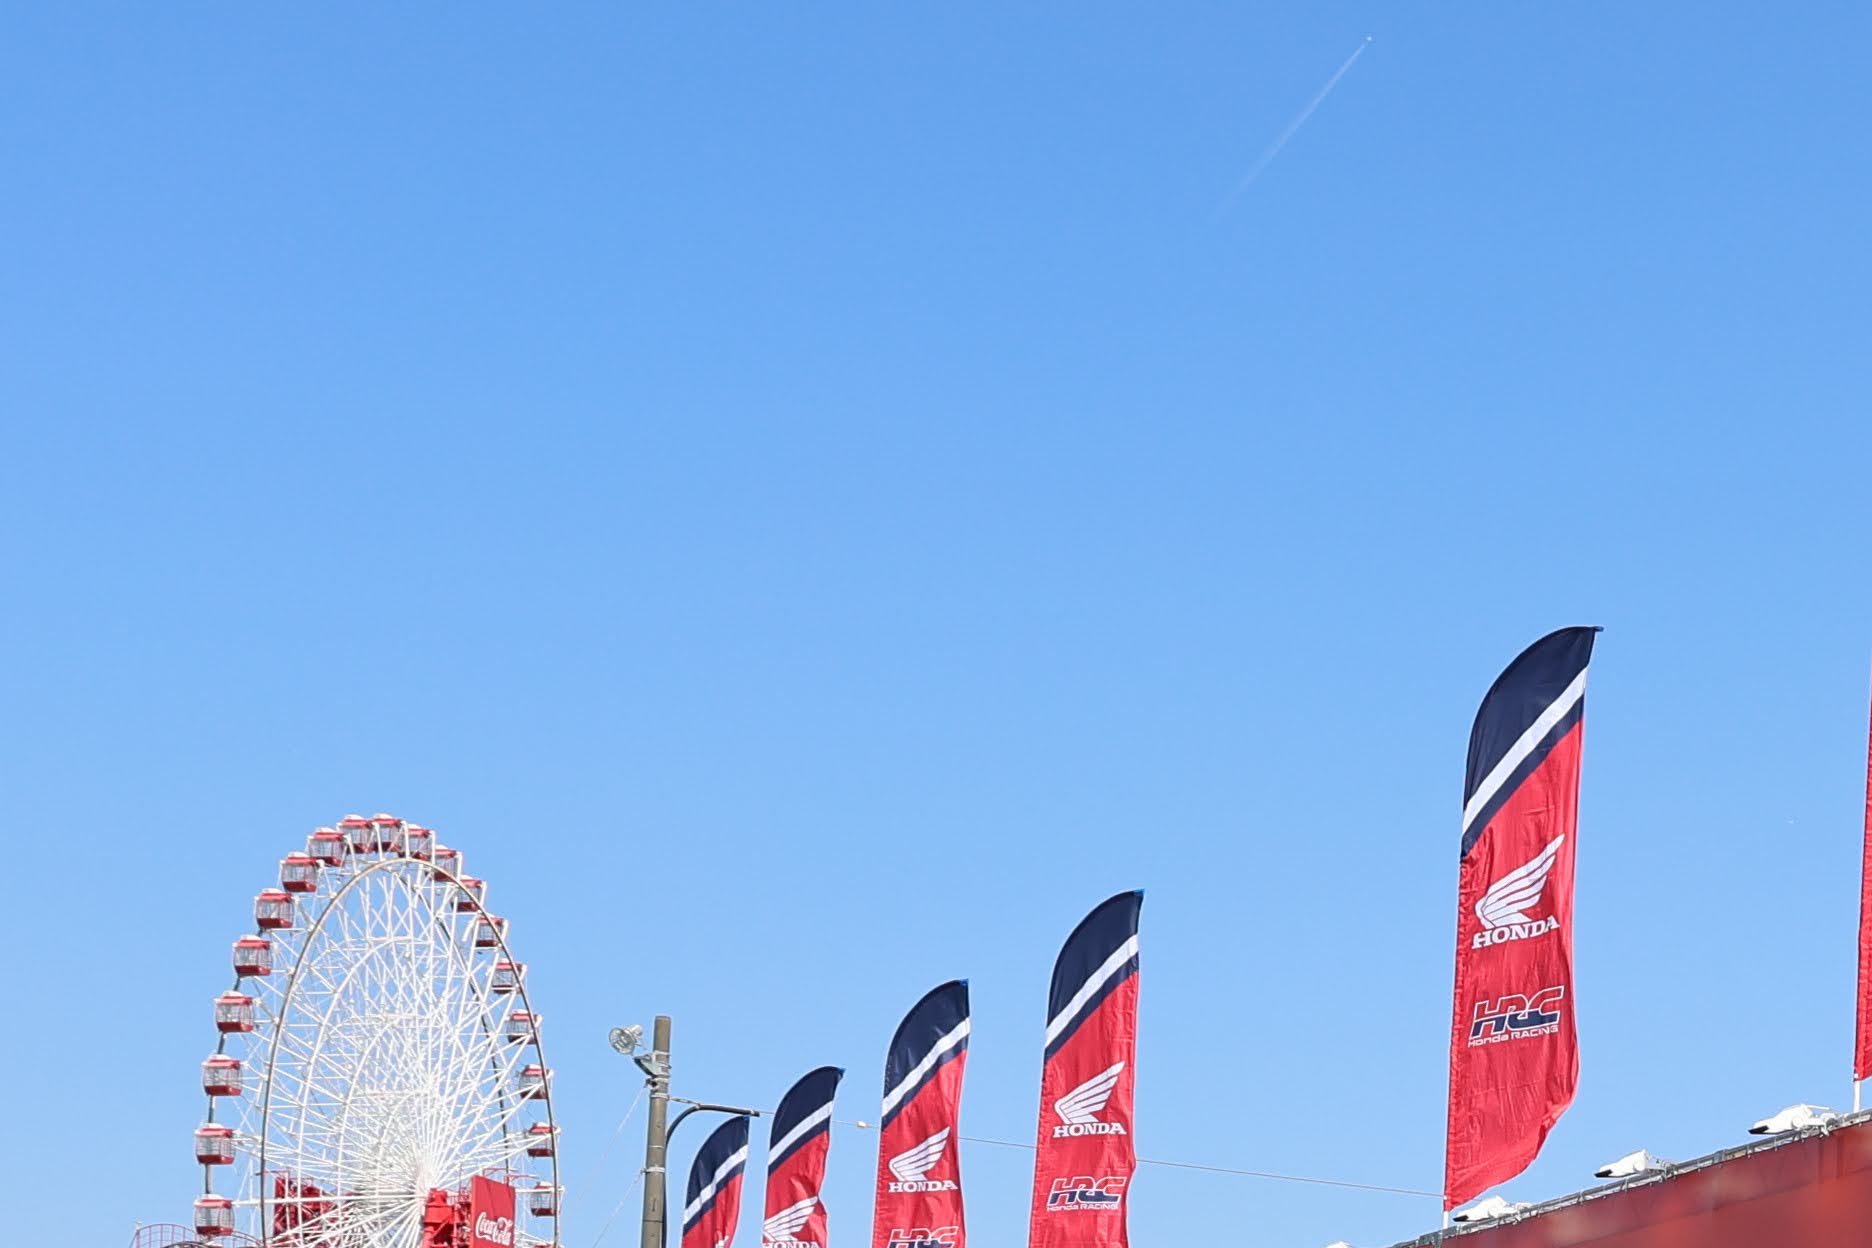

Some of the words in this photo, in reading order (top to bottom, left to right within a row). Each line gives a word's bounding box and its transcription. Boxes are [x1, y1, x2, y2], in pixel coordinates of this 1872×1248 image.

[1472, 915, 1560, 949] HONDA
[1469, 985, 1565, 1040] HRC
[1468, 1035, 1508, 1048] Honda
[1511, 1024, 1559, 1039] RACING
[1052, 1122, 1127, 1138] HONDA
[889, 1179, 958, 1193] HONDA
[1047, 1176, 1127, 1205] HRC
[1080, 1202, 1119, 1210] RACING
